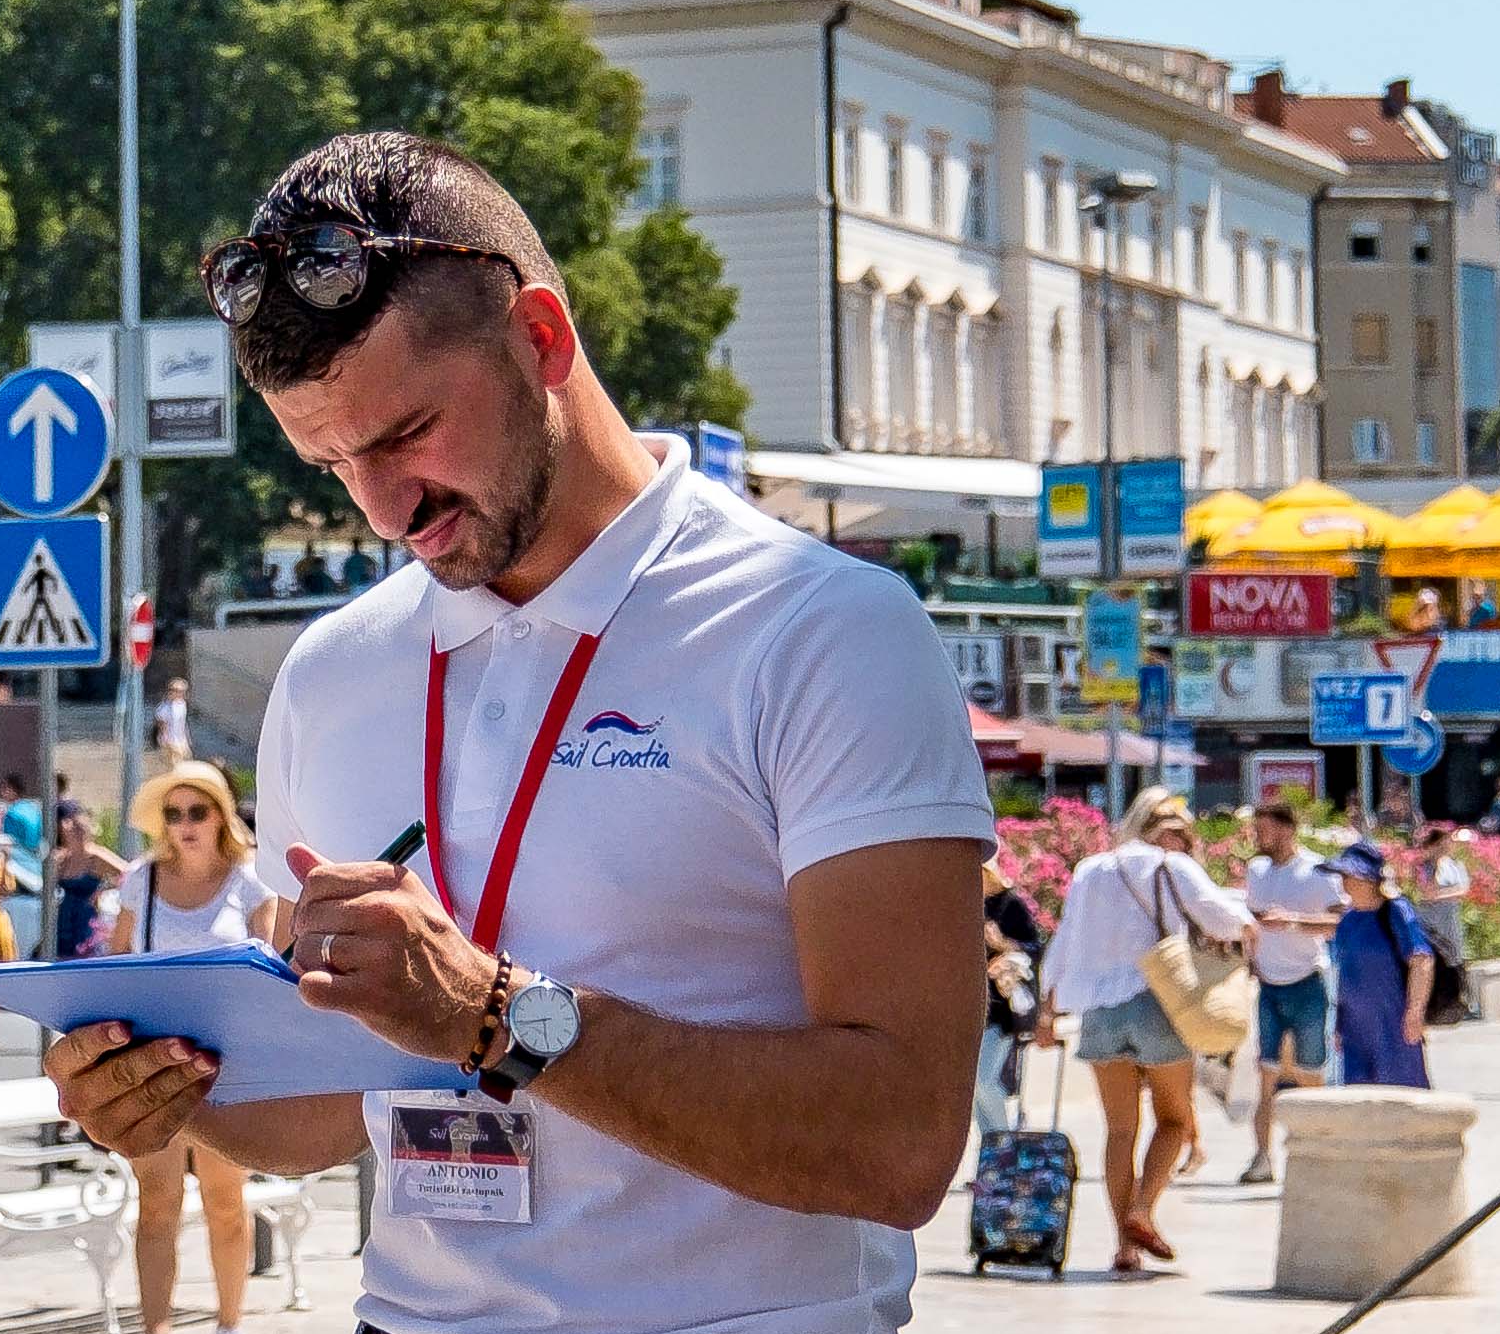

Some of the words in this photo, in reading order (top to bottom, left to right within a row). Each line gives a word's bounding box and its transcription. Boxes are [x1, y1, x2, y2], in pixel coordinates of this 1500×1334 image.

[1210, 577, 1309, 612] NOVA
[1377, 690, 1393, 722] 7
[551, 739, 589, 768] Sail
[591, 739, 671, 768] Croatia
[427, 1164, 499, 1180] ANTONIO
